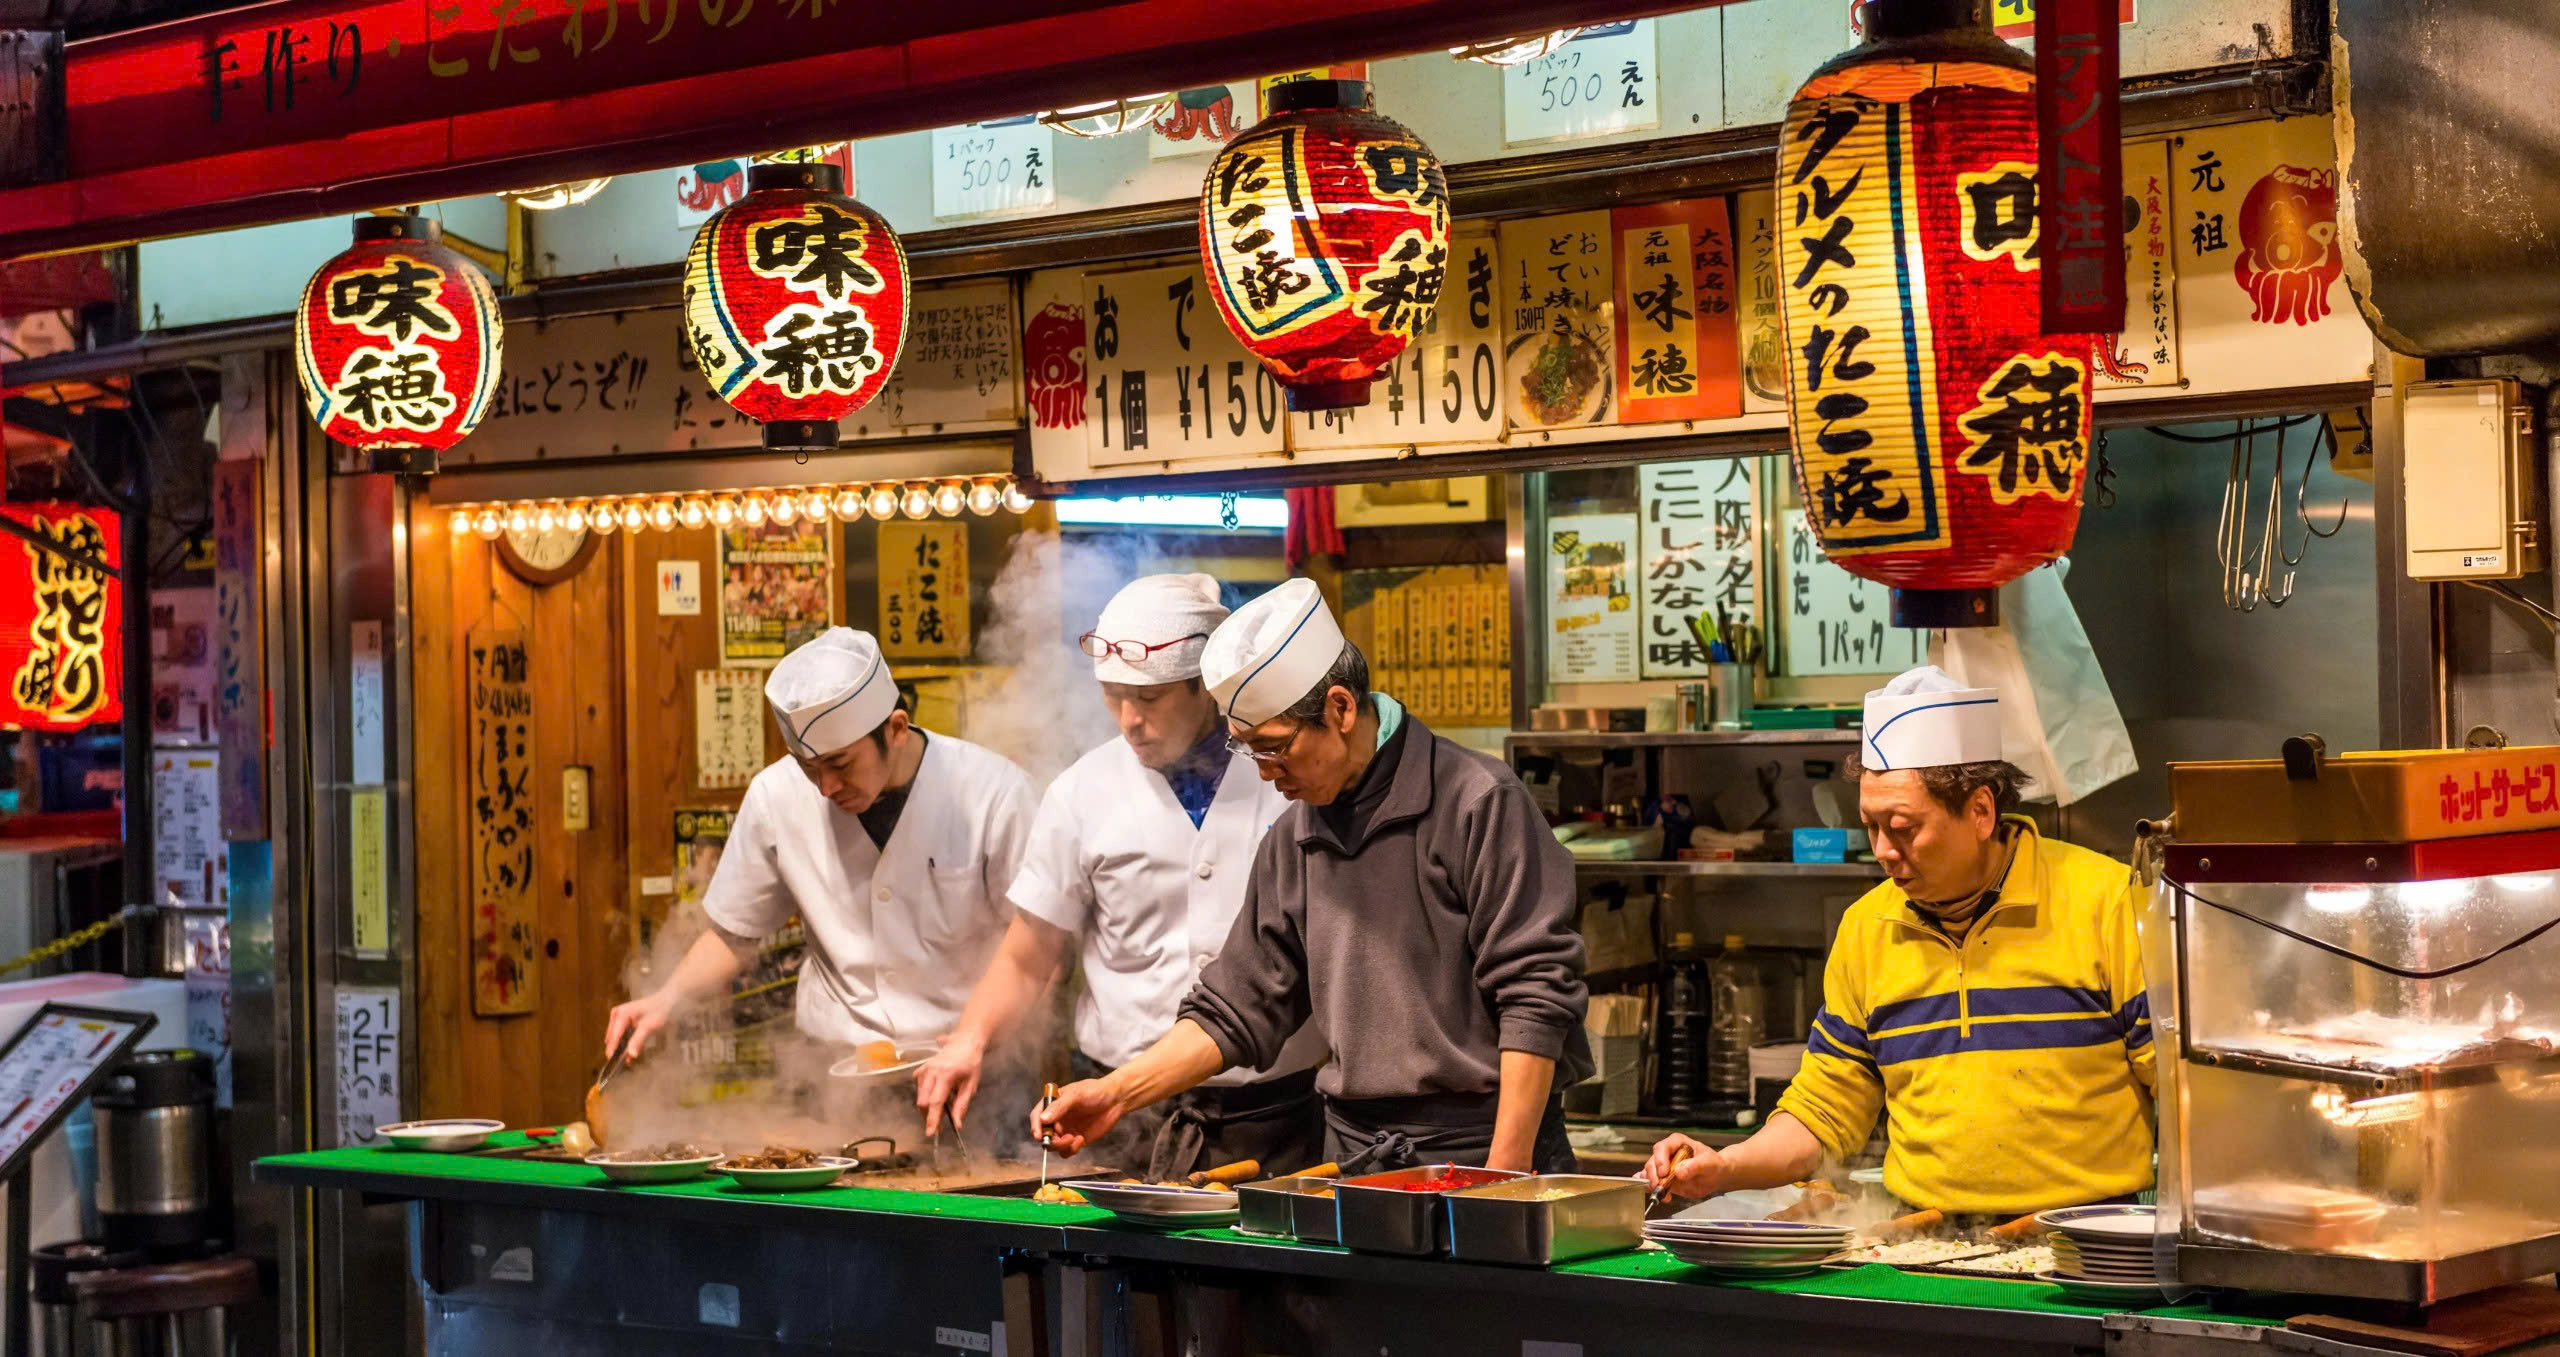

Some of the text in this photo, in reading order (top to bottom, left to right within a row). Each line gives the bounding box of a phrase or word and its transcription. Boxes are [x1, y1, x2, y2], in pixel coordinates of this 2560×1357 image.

[1523, 52, 1581, 77] 1パック
[1541, 73, 1602, 112] 500
[1621, 61, 1644, 108] えん
[947, 138, 995, 160] 1パック
[962, 157, 1012, 191] 500
[1025, 147, 1044, 189] えん
[2055, 32, 2108, 306] テント注意
[1218, 151, 1312, 314] たこ焼
[1361, 145, 1451, 338] 味穂
[2146, 175, 2165, 257] 大阪名物
[2190, 150, 2229, 257] 元祖
[755, 206, 877, 394] 味穂
[1544, 233, 1575, 336] どて焼き
[1631, 231, 1697, 396] 元祖 味穂
[1694, 228, 1729, 315] 大阪名物
[1793, 100, 1910, 527] グルメのたこ焼
[332, 261, 459, 428] 味穂
[963, 306, 975, 360] ちくわ
[996, 304, 1009, 376] だいこん
[1094, 275, 1195, 361] おで
[1096, 361, 1277, 451] 1個 ¥150
[1388, 343, 1496, 426] ¥150
[1713, 457, 1754, 626] 大阪名
[915, 534, 944, 645] たこ焼
[1819, 619, 1884, 668] 1パック
[2440, 764, 2559, 824] ホットサービス
